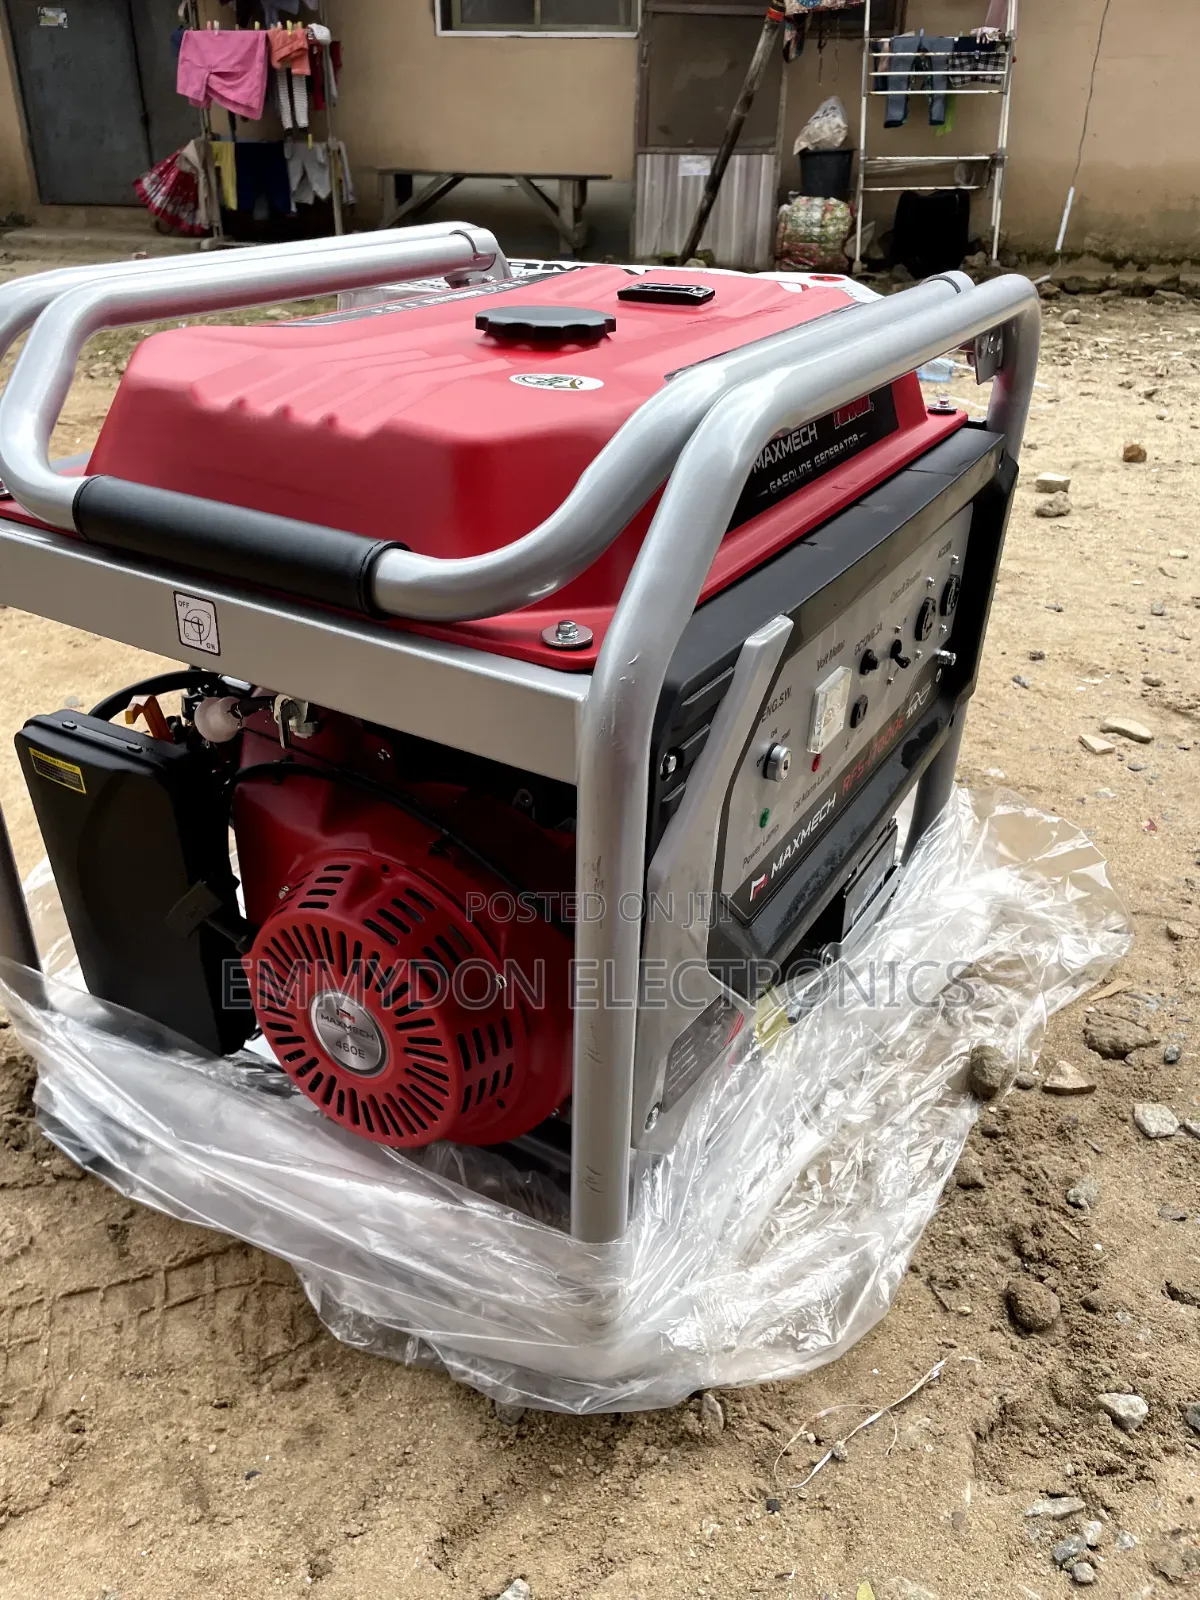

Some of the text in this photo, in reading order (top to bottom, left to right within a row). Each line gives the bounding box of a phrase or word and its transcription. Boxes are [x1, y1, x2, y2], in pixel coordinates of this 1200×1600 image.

[753, 422, 818, 474] MAXMECH
[769, 433, 860, 494] GASOLINE GENERATOR
[178, 600, 190, 609] OFF
[206, 642, 216, 651] ON
[742, 824, 780, 869] Power Lamp
[771, 792, 837, 879] MAXMECH
[321, 1013, 375, 1041] MAXMECH
[336, 1040, 366, 1060] 460E
